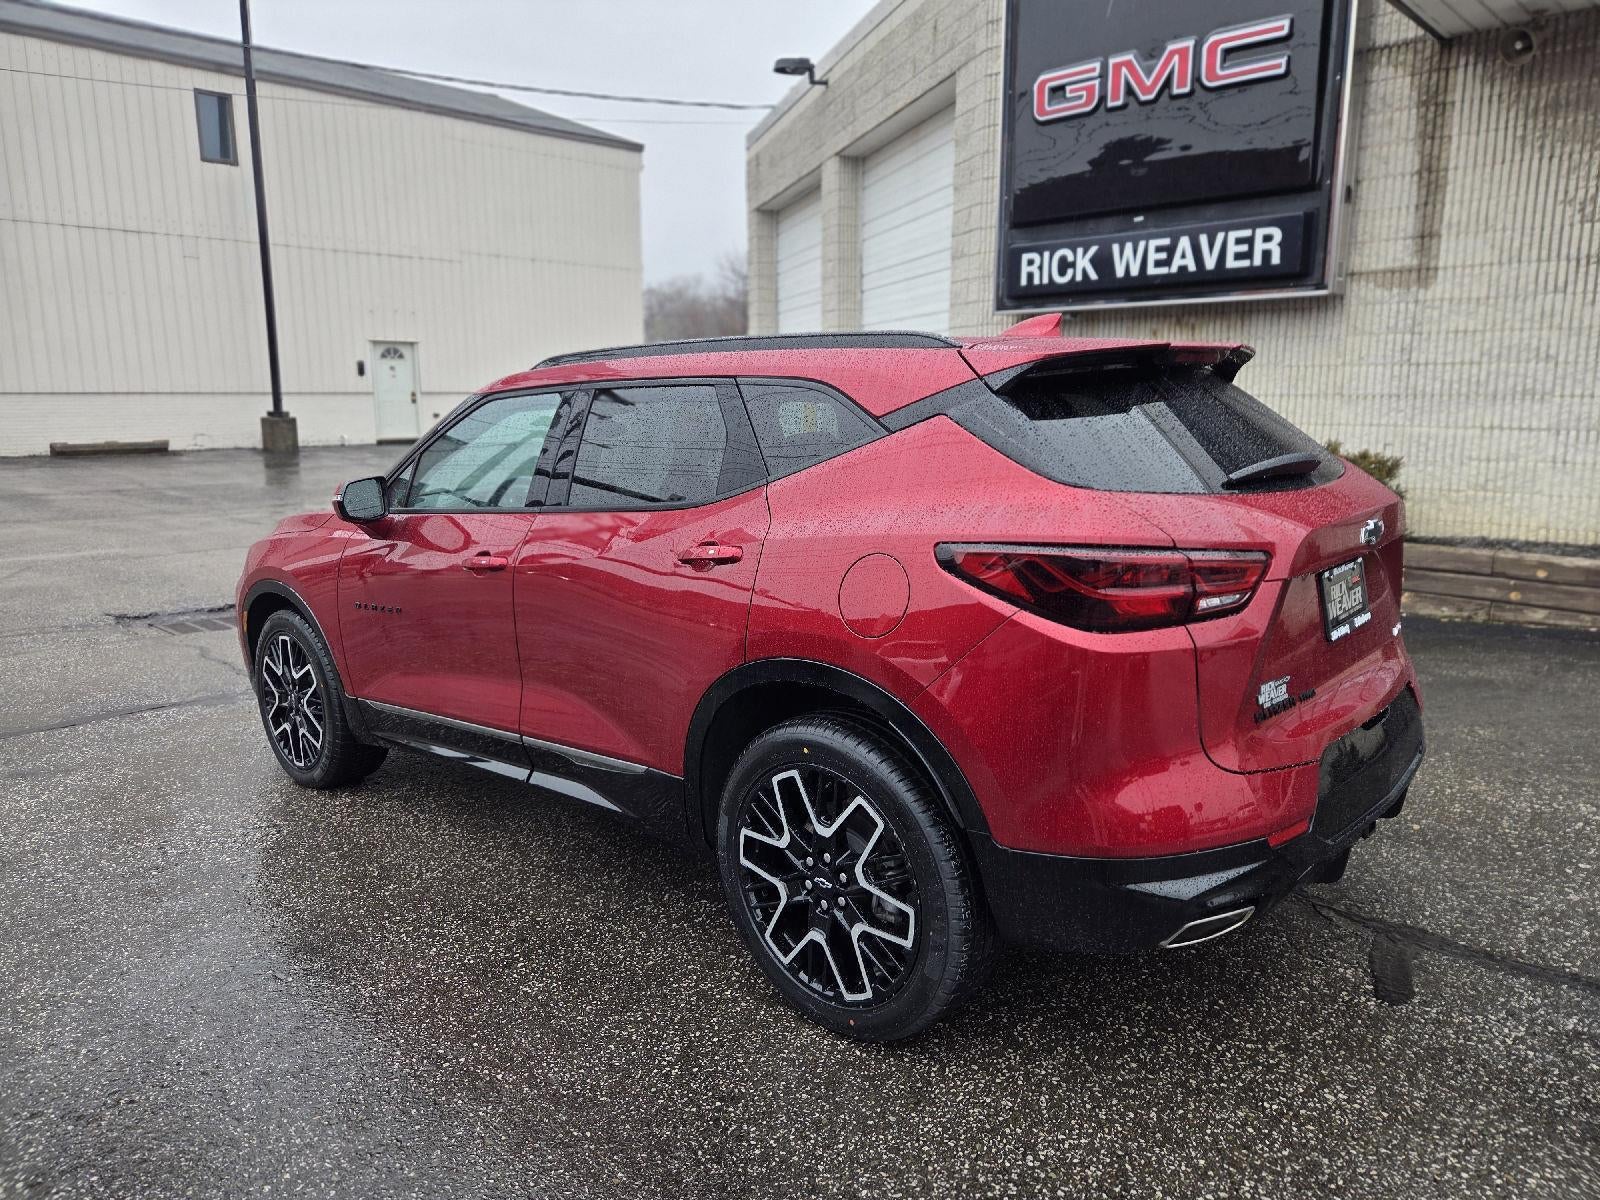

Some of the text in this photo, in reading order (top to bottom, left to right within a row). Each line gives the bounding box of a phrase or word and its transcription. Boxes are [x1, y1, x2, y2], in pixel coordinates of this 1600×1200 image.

[1033, 16, 1292, 121] GMC
[1020, 226, 1283, 287] RICK WEAVER
[1328, 585, 1363, 620] WEAVER
[1330, 580, 1348, 600] RICK
